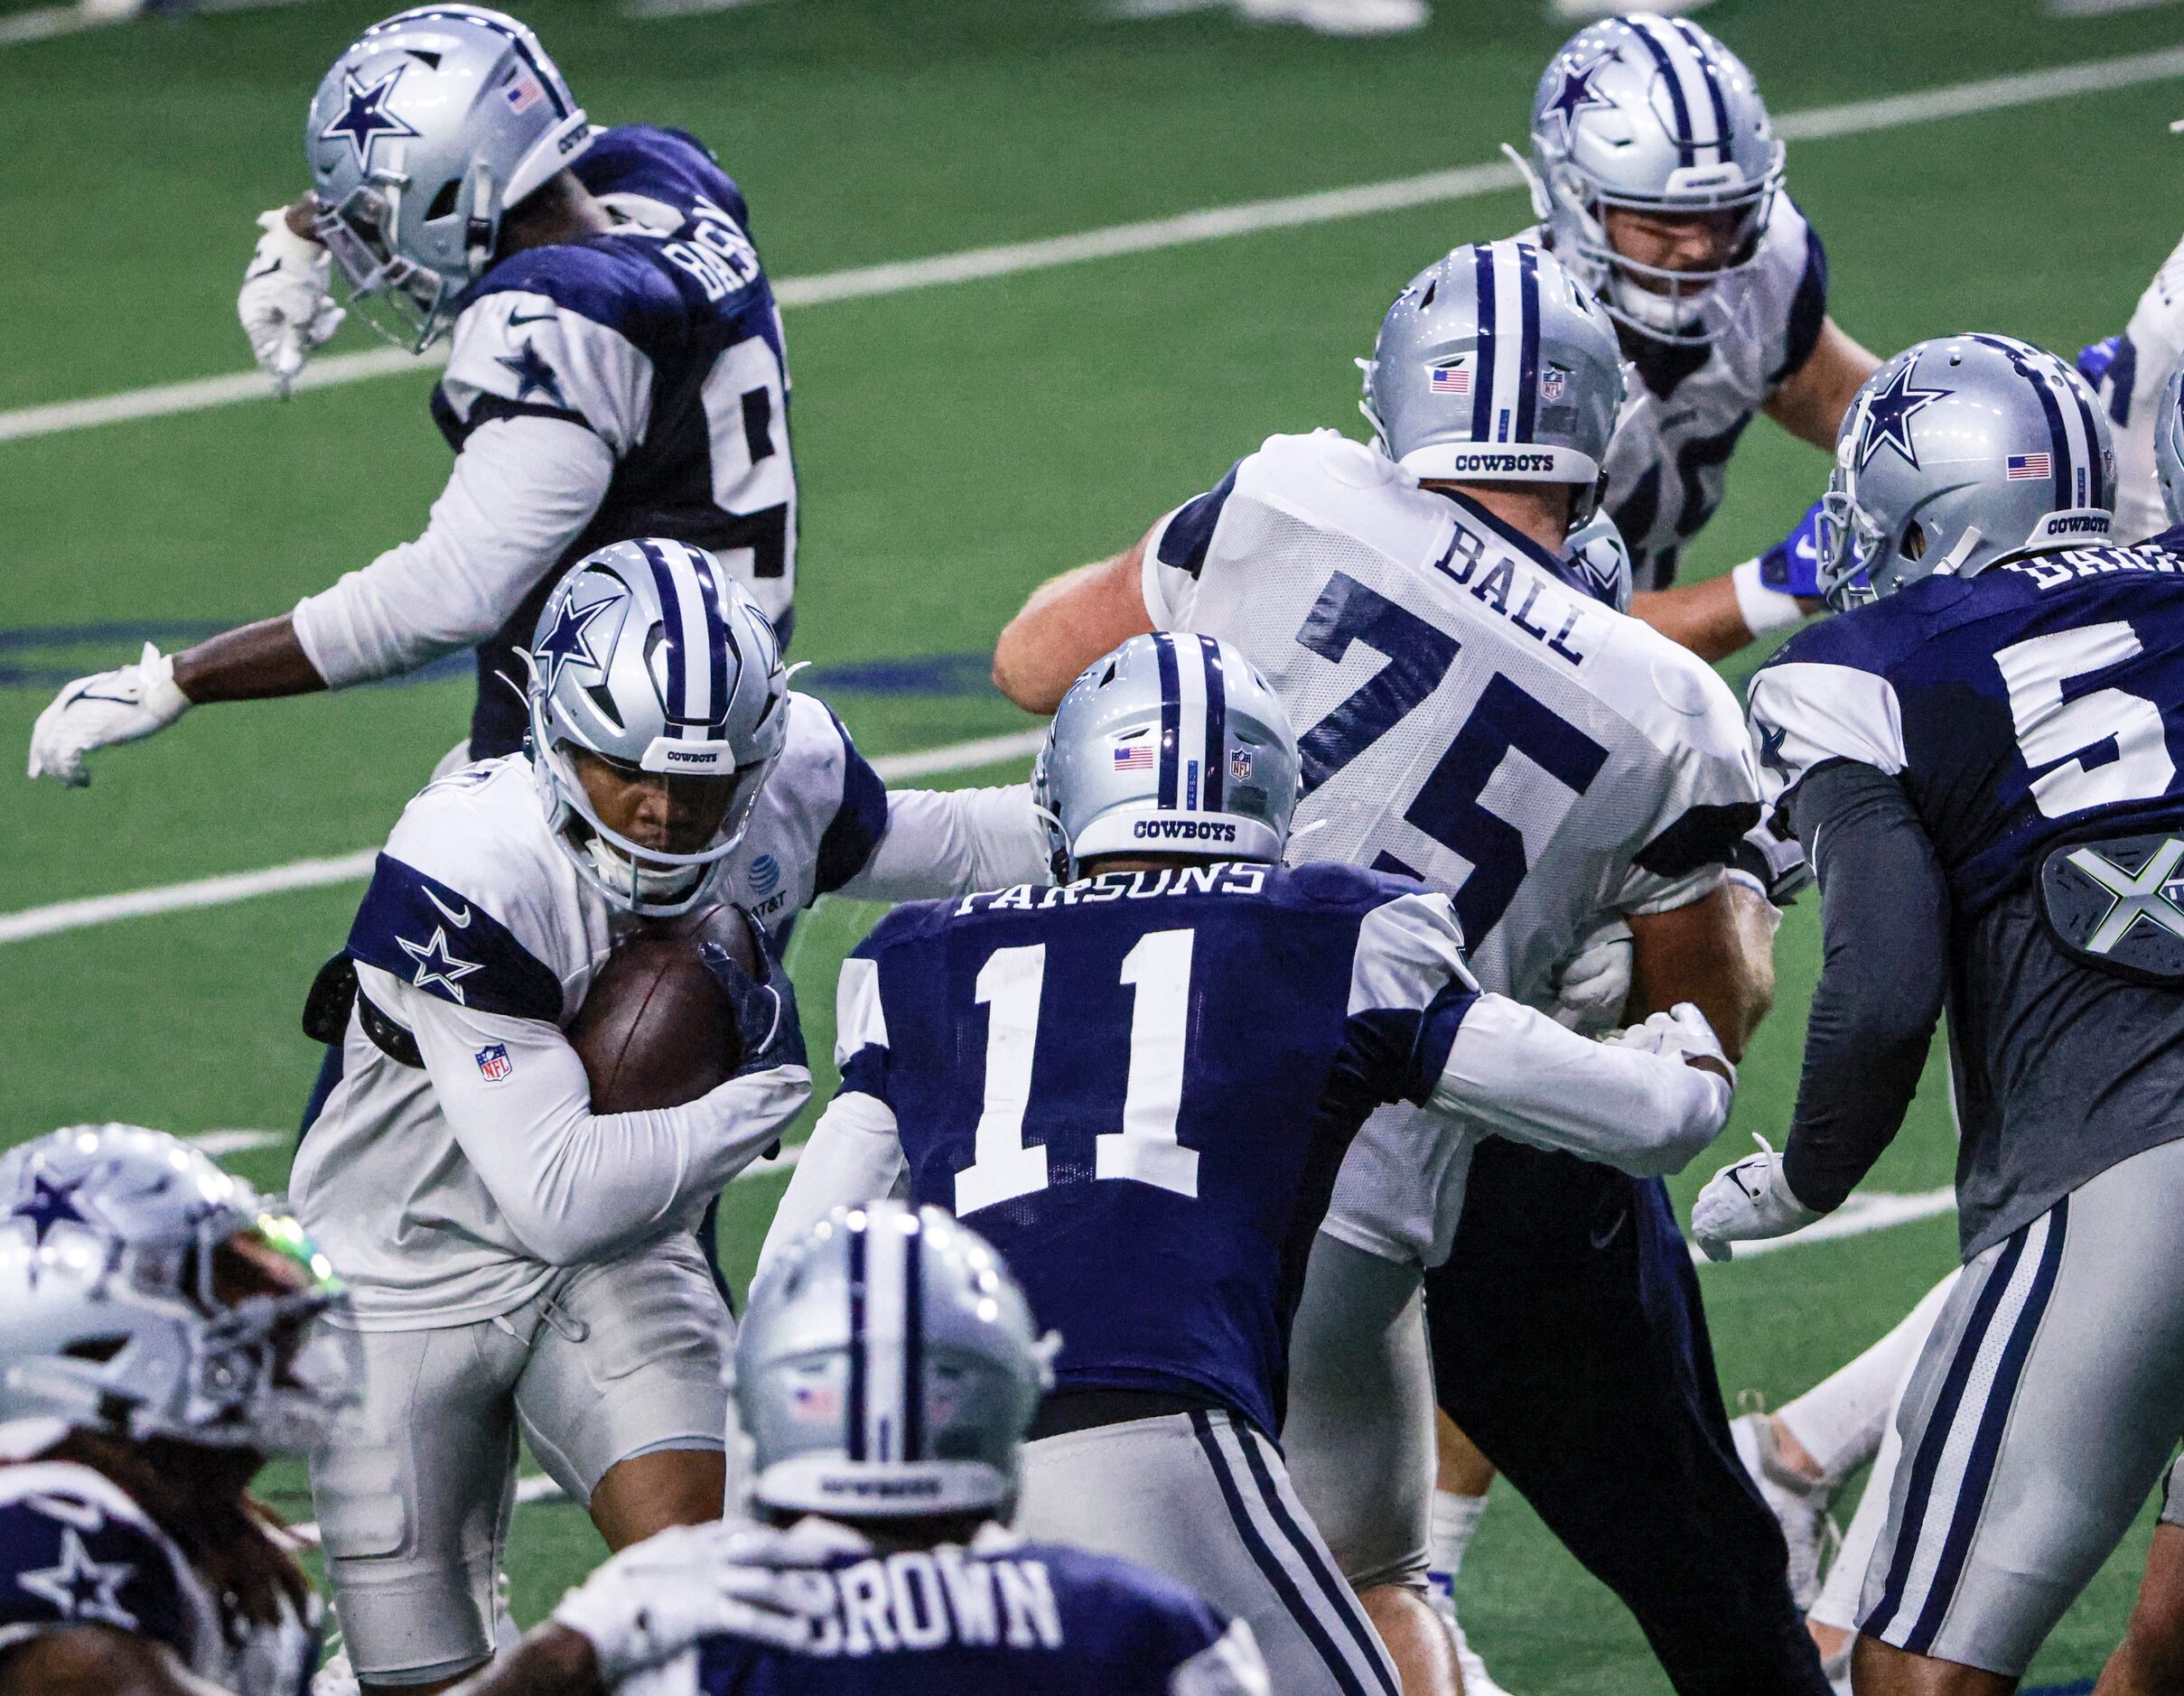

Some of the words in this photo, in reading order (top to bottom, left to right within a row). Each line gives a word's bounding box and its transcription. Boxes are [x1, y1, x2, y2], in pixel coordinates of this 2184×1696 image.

[1455, 454, 1554, 471] COWBOYS
[1434, 521, 1584, 666] BALL
[1295, 570, 1610, 966] 75
[1134, 820, 1237, 843] COWBOYS
[751, 890, 787, 917] AT&T
[481, 1058, 509, 1079] NFL
[955, 928, 1199, 1218] 11
